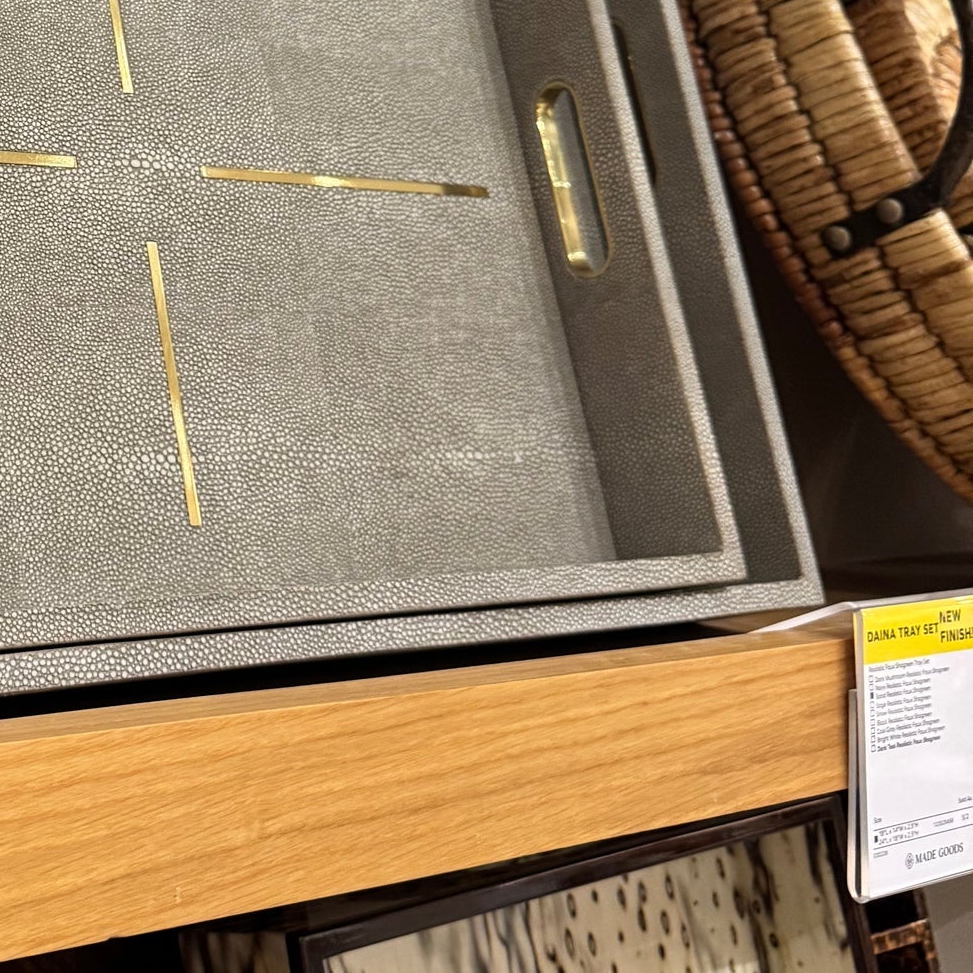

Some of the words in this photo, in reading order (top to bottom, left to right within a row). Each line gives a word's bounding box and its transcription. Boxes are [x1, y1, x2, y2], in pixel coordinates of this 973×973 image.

[939, 609, 961, 624] NEW
[867, 628, 896, 642] DAINA
[898, 625, 921, 638] TRAY
[923, 622, 939, 635] SET
[915, 849, 936, 864] MADE
[938, 843, 963, 857] GOODS
